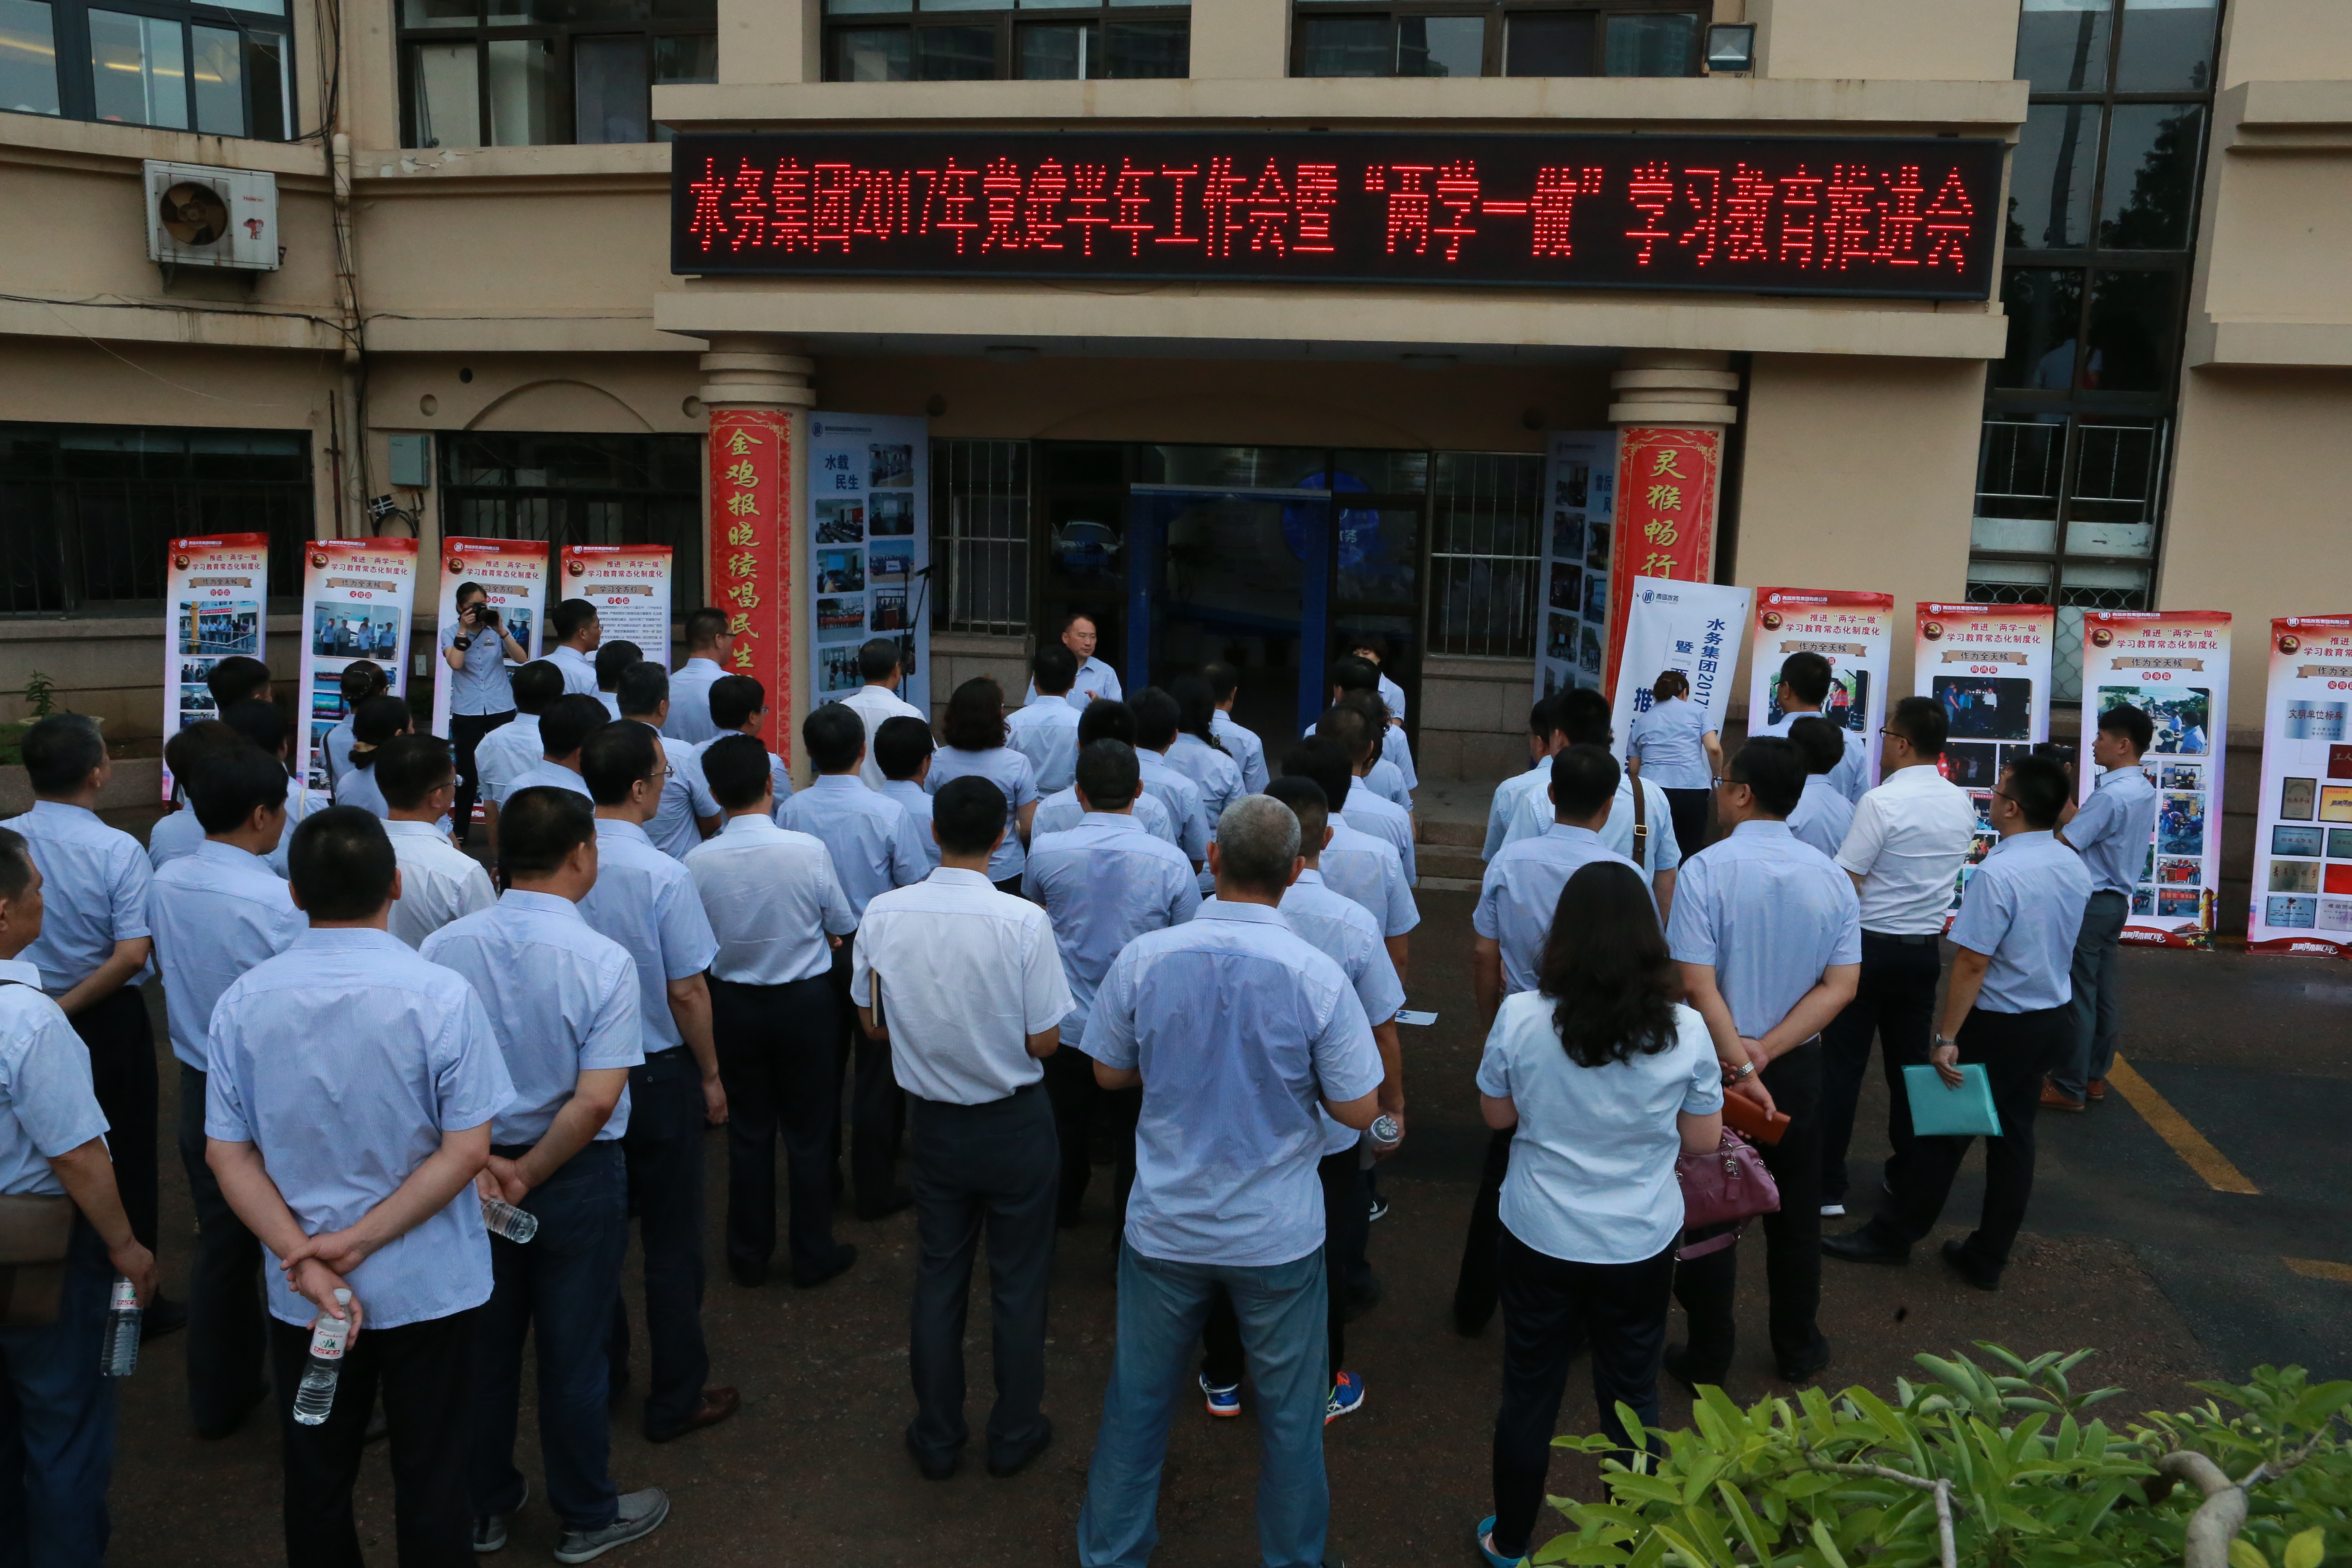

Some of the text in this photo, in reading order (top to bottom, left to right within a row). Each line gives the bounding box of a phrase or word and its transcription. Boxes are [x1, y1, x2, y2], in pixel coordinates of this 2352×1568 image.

[825, 454, 849, 470] 水载
[836, 474, 859, 490] 民生
[1641, 450, 1686, 579] 灵猴畅行
[725, 428, 763, 678] 金鸡报晓续唱民生
[331, 564, 408, 575] 学习教育常态化制度化
[466, 568, 539, 579] 学习教育常态化制度化
[342, 579, 382, 588] 作为全天候
[1656, 593, 1679, 603] 青岛水务
[1786, 623, 1880, 635] 学习教育常态化制度化
[1947, 633, 2041, 644] 学习教育常态化制度化
[1799, 642, 1847, 652] 作为全天候
[2117, 640, 2218, 649] 学习教育常态化制度化
[1960, 652, 2009, 661] 作为全天候
[1694, 618, 1725, 709] 水务集团2017
[2132, 658, 2183, 667] 作为全天候
[2318, 666, 2352, 676] 作为全
[2288, 709, 2343, 720] 文明单位标兵
